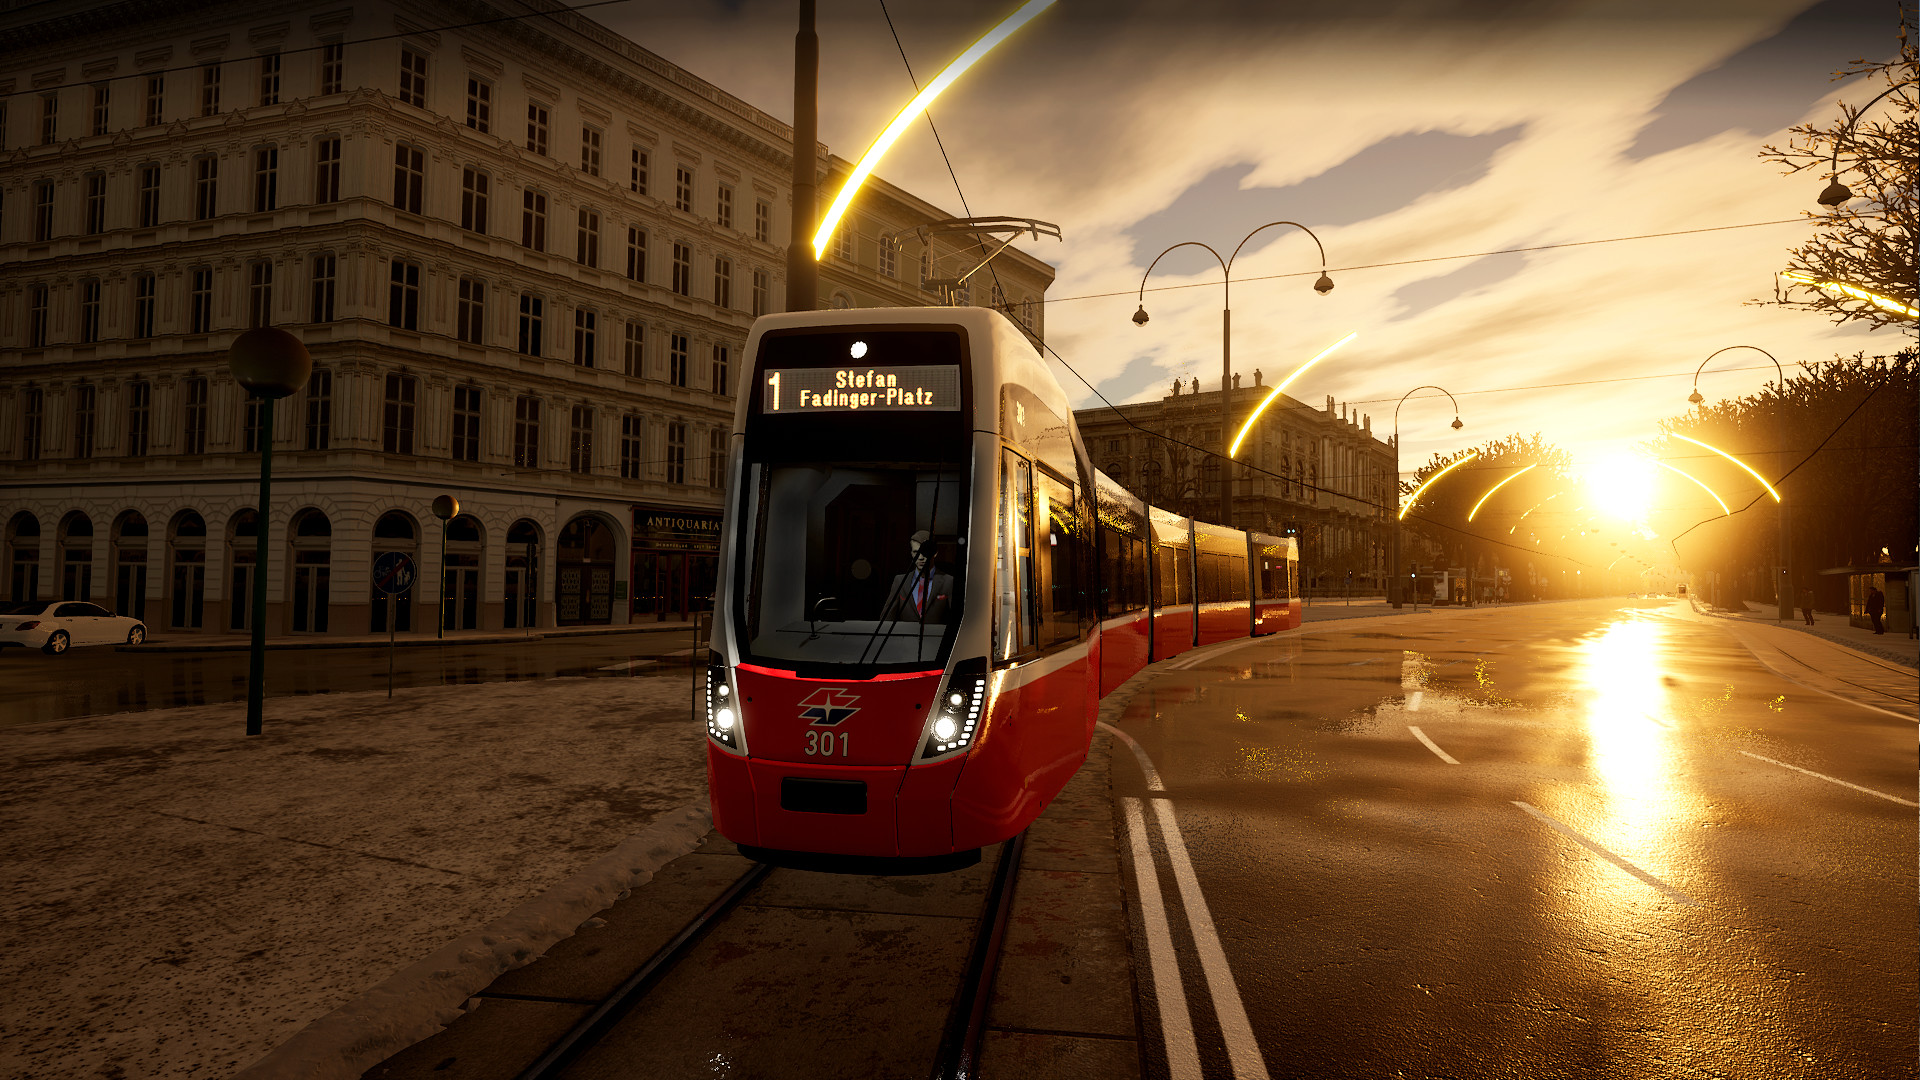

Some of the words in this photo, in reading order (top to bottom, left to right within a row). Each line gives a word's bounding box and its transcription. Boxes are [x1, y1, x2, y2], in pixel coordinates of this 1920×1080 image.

[768, 371, 781, 411] 1
[835, 370, 897, 388] Stefan
[800, 387, 933, 409] Fadinger-Platz
[804, 730, 849, 757] 301
